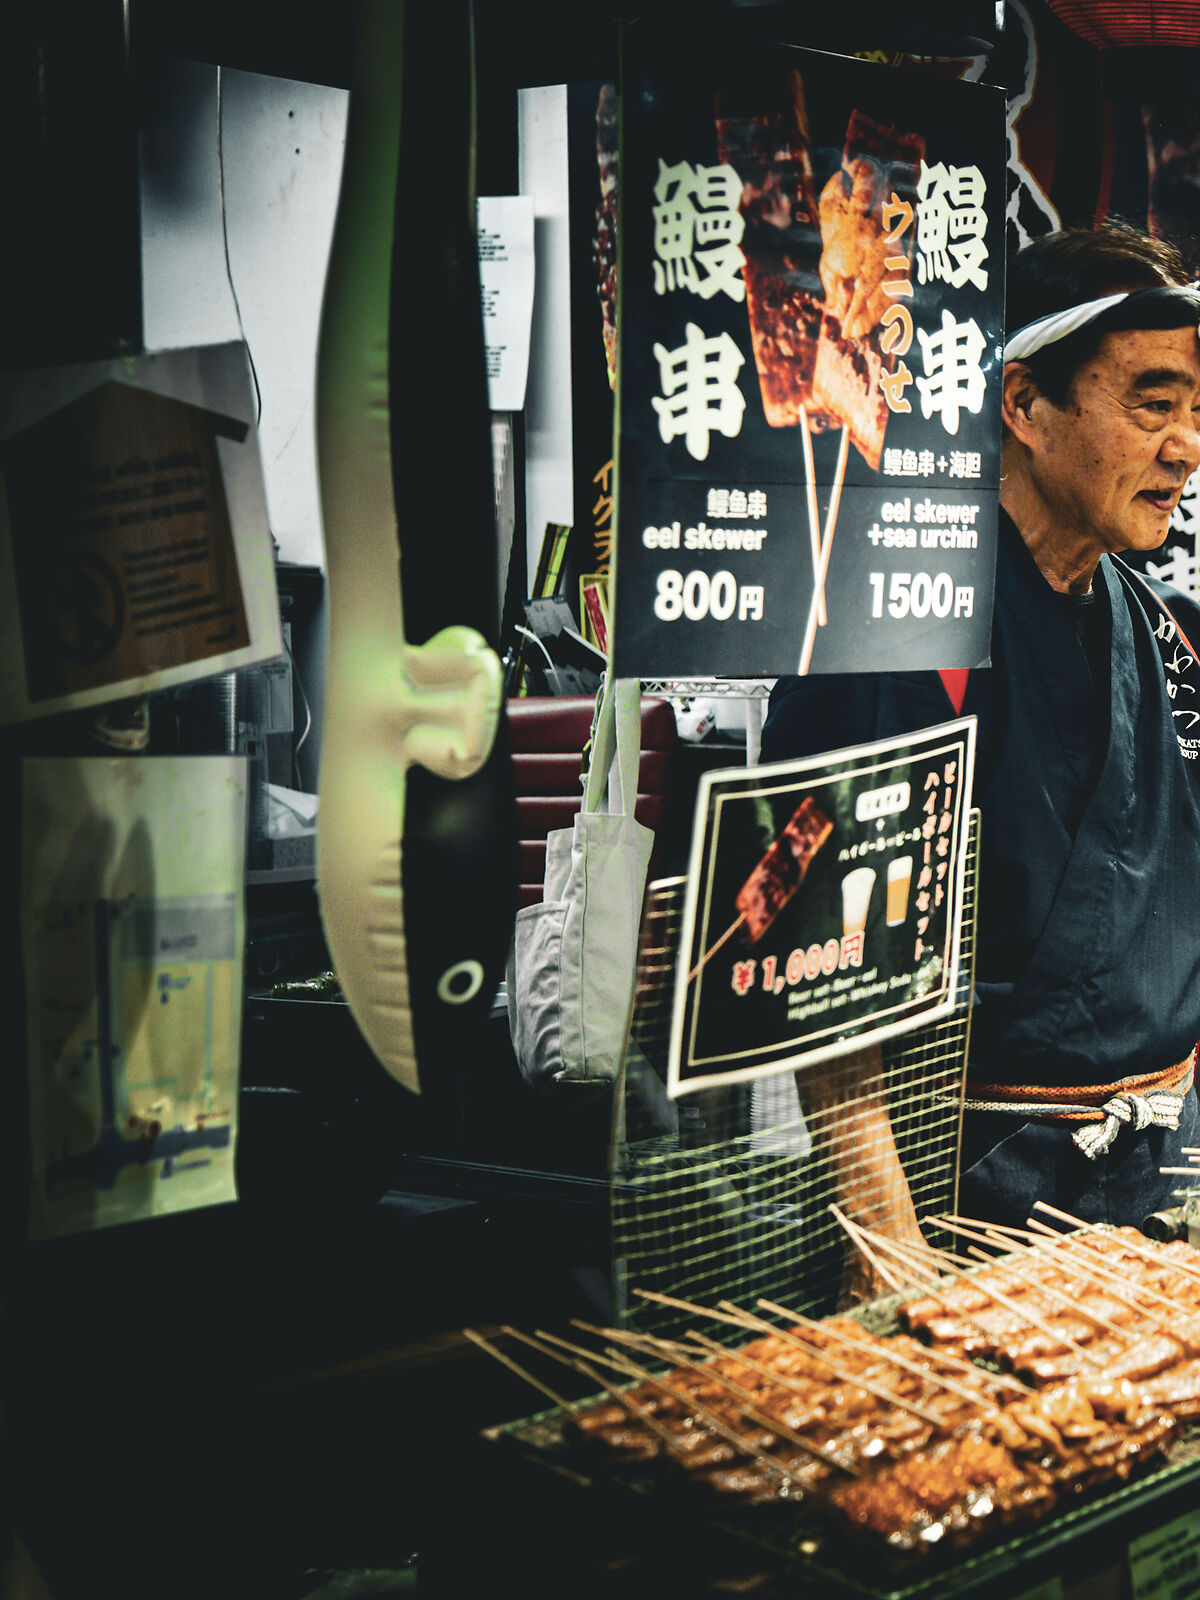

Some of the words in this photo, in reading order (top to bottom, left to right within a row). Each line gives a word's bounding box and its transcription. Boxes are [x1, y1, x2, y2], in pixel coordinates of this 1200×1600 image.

[652, 157, 746, 461] 鰻串
[879, 192, 914, 414] ウニのせ
[916, 159, 989, 435] 鰻串
[881, 498, 911, 523] eel
[913, 498, 980, 524] skewer
[642, 521, 681, 549] eel
[684, 522, 768, 551] skewer
[867, 523, 918, 548] +sea
[920, 524, 978, 549] urchin
[654, 569, 765, 621] 800円
[869, 572, 975, 619] 1500円
